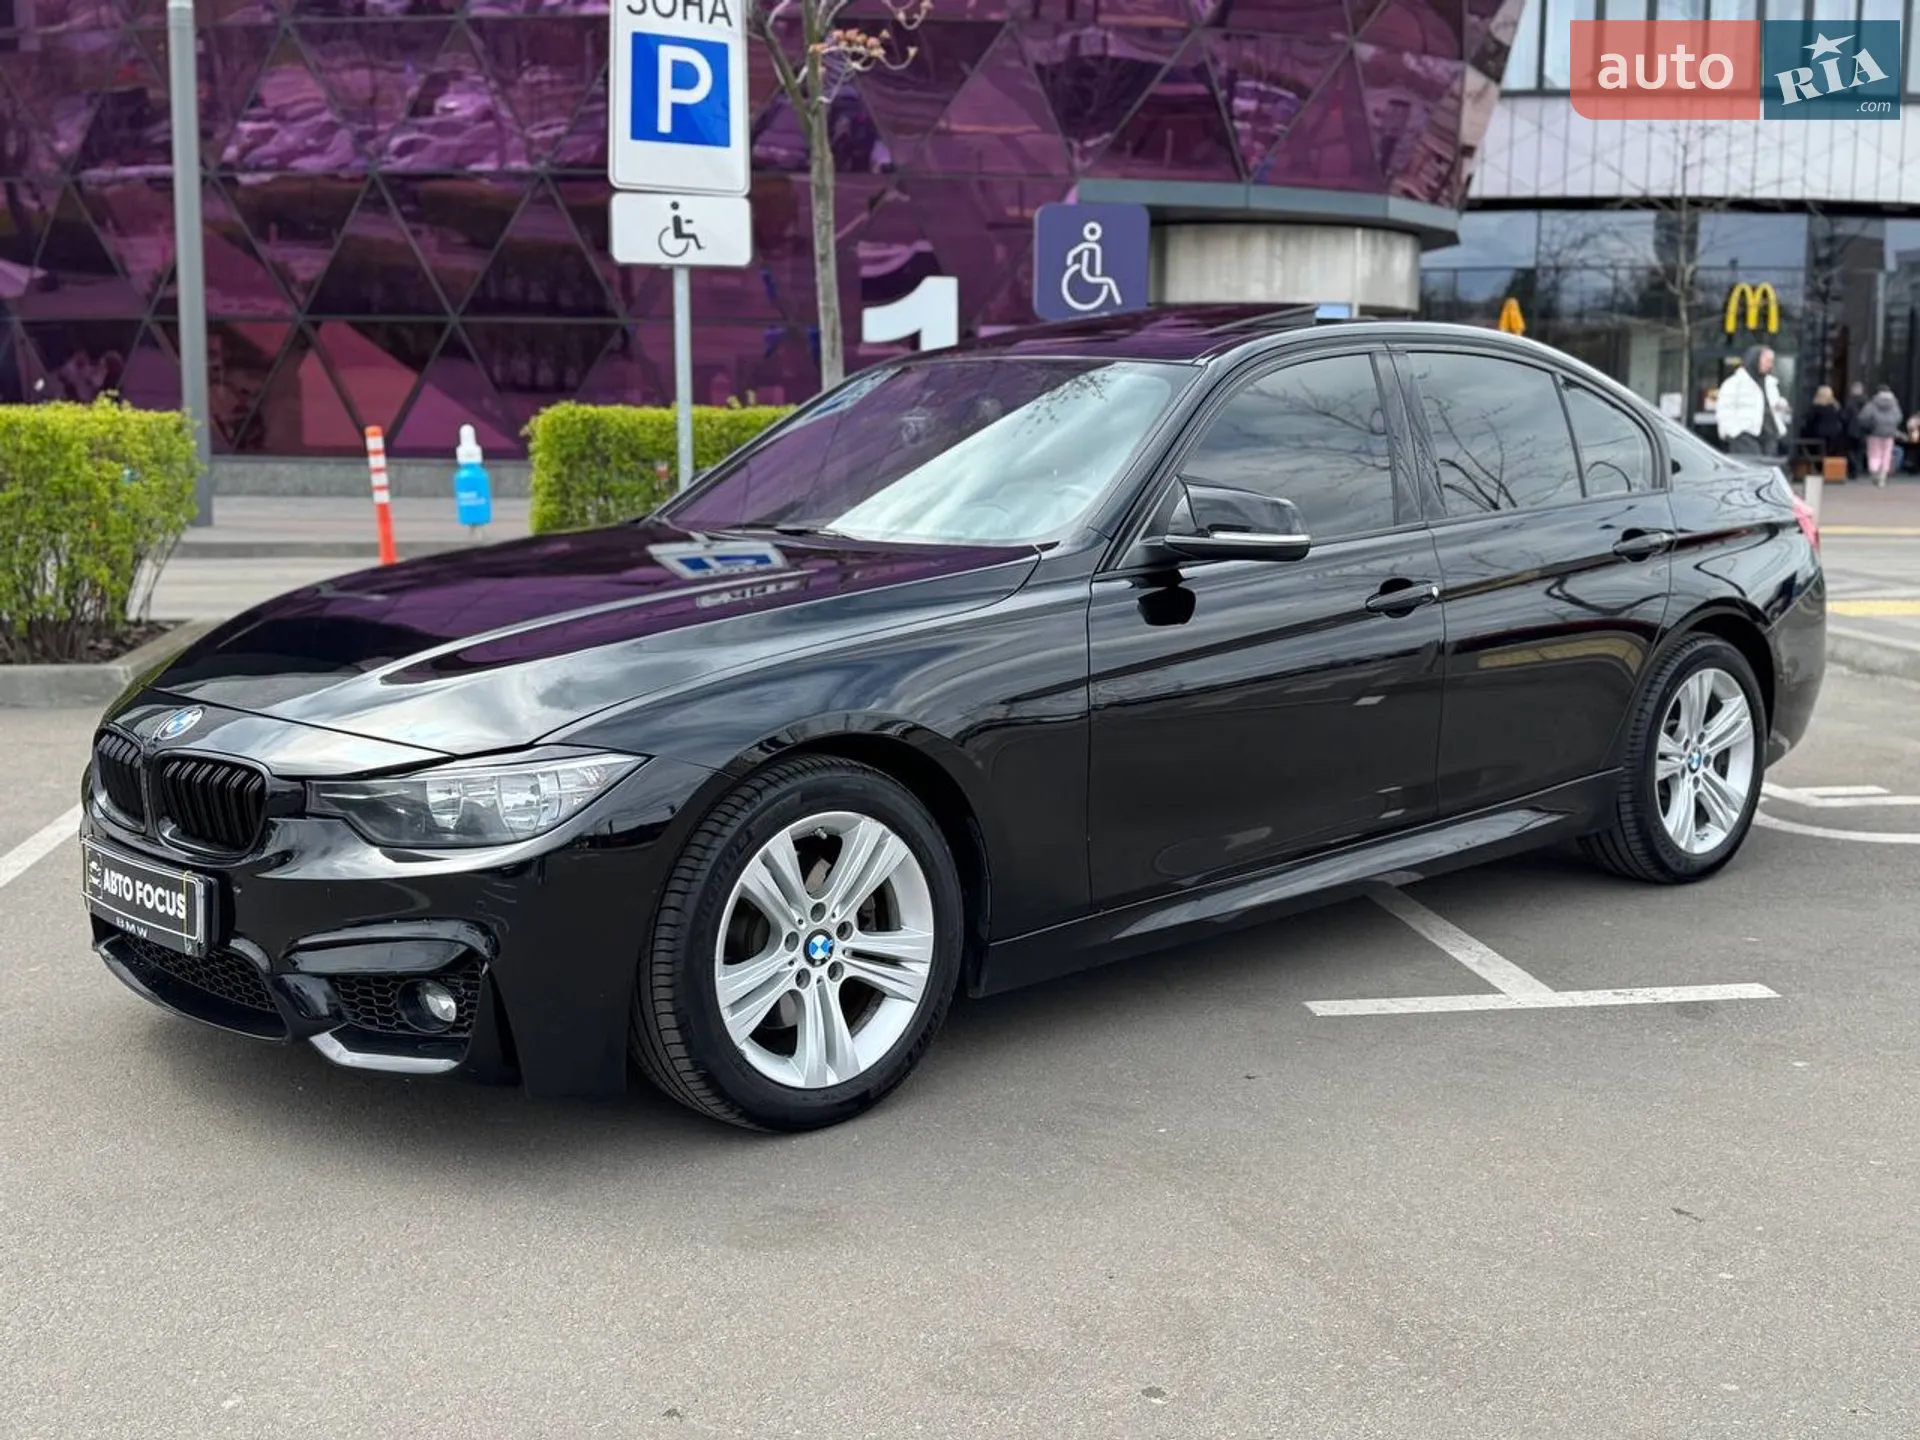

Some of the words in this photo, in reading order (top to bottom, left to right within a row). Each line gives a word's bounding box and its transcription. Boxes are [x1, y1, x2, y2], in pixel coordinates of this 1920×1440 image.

[657, 44, 713, 134] P
[862, 275, 959, 352] 1
[135, 880, 186, 919] FOCUS
